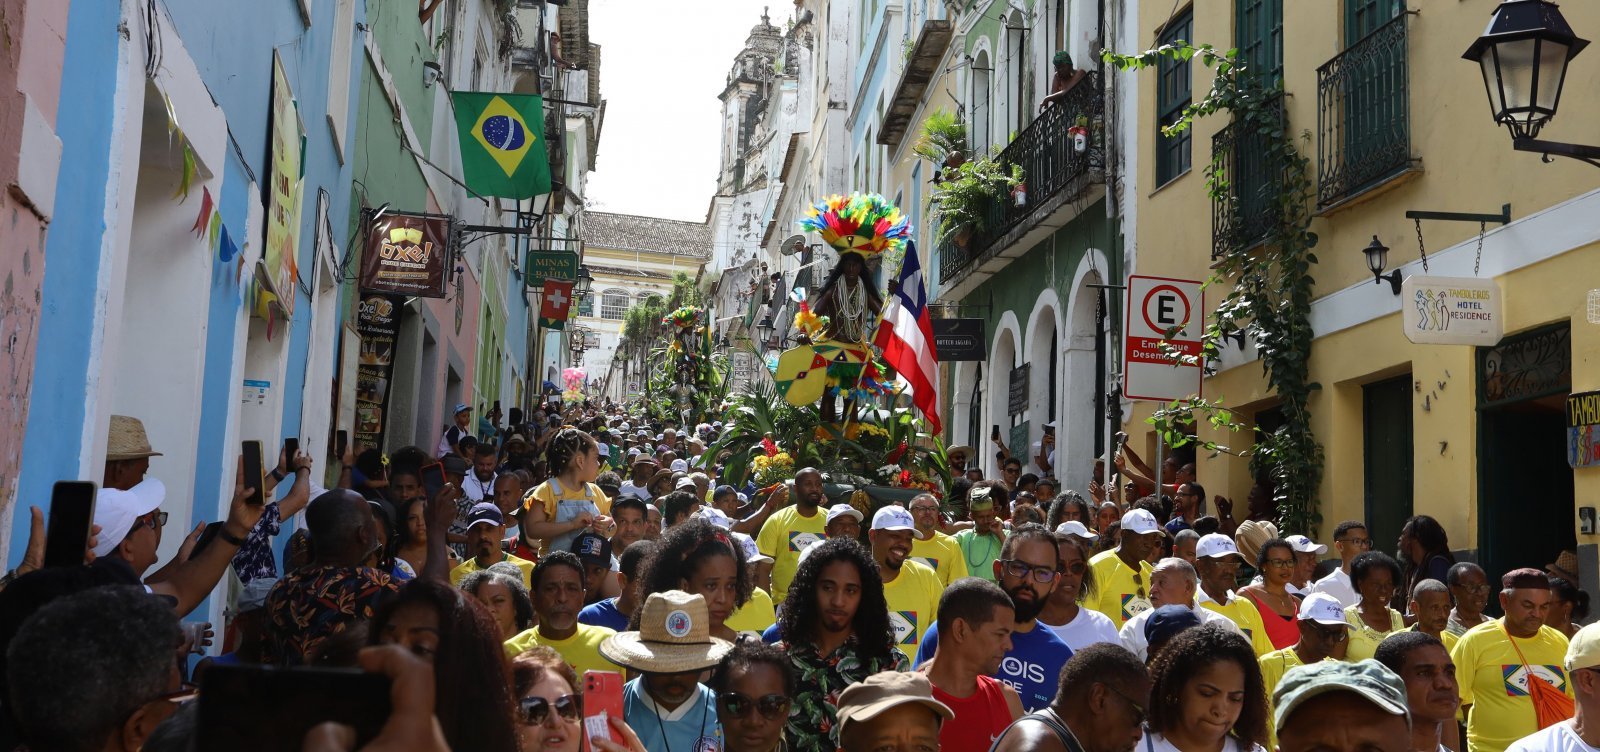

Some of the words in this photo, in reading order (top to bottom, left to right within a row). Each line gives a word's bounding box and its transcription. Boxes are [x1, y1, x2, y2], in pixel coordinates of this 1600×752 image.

[536, 259, 570, 267] MINAS
[1158, 295, 1175, 324] E
[1457, 301, 1482, 310] HOTEL
[1450, 311, 1492, 321] RESIDENCE
[999, 656, 1045, 684] OIS
